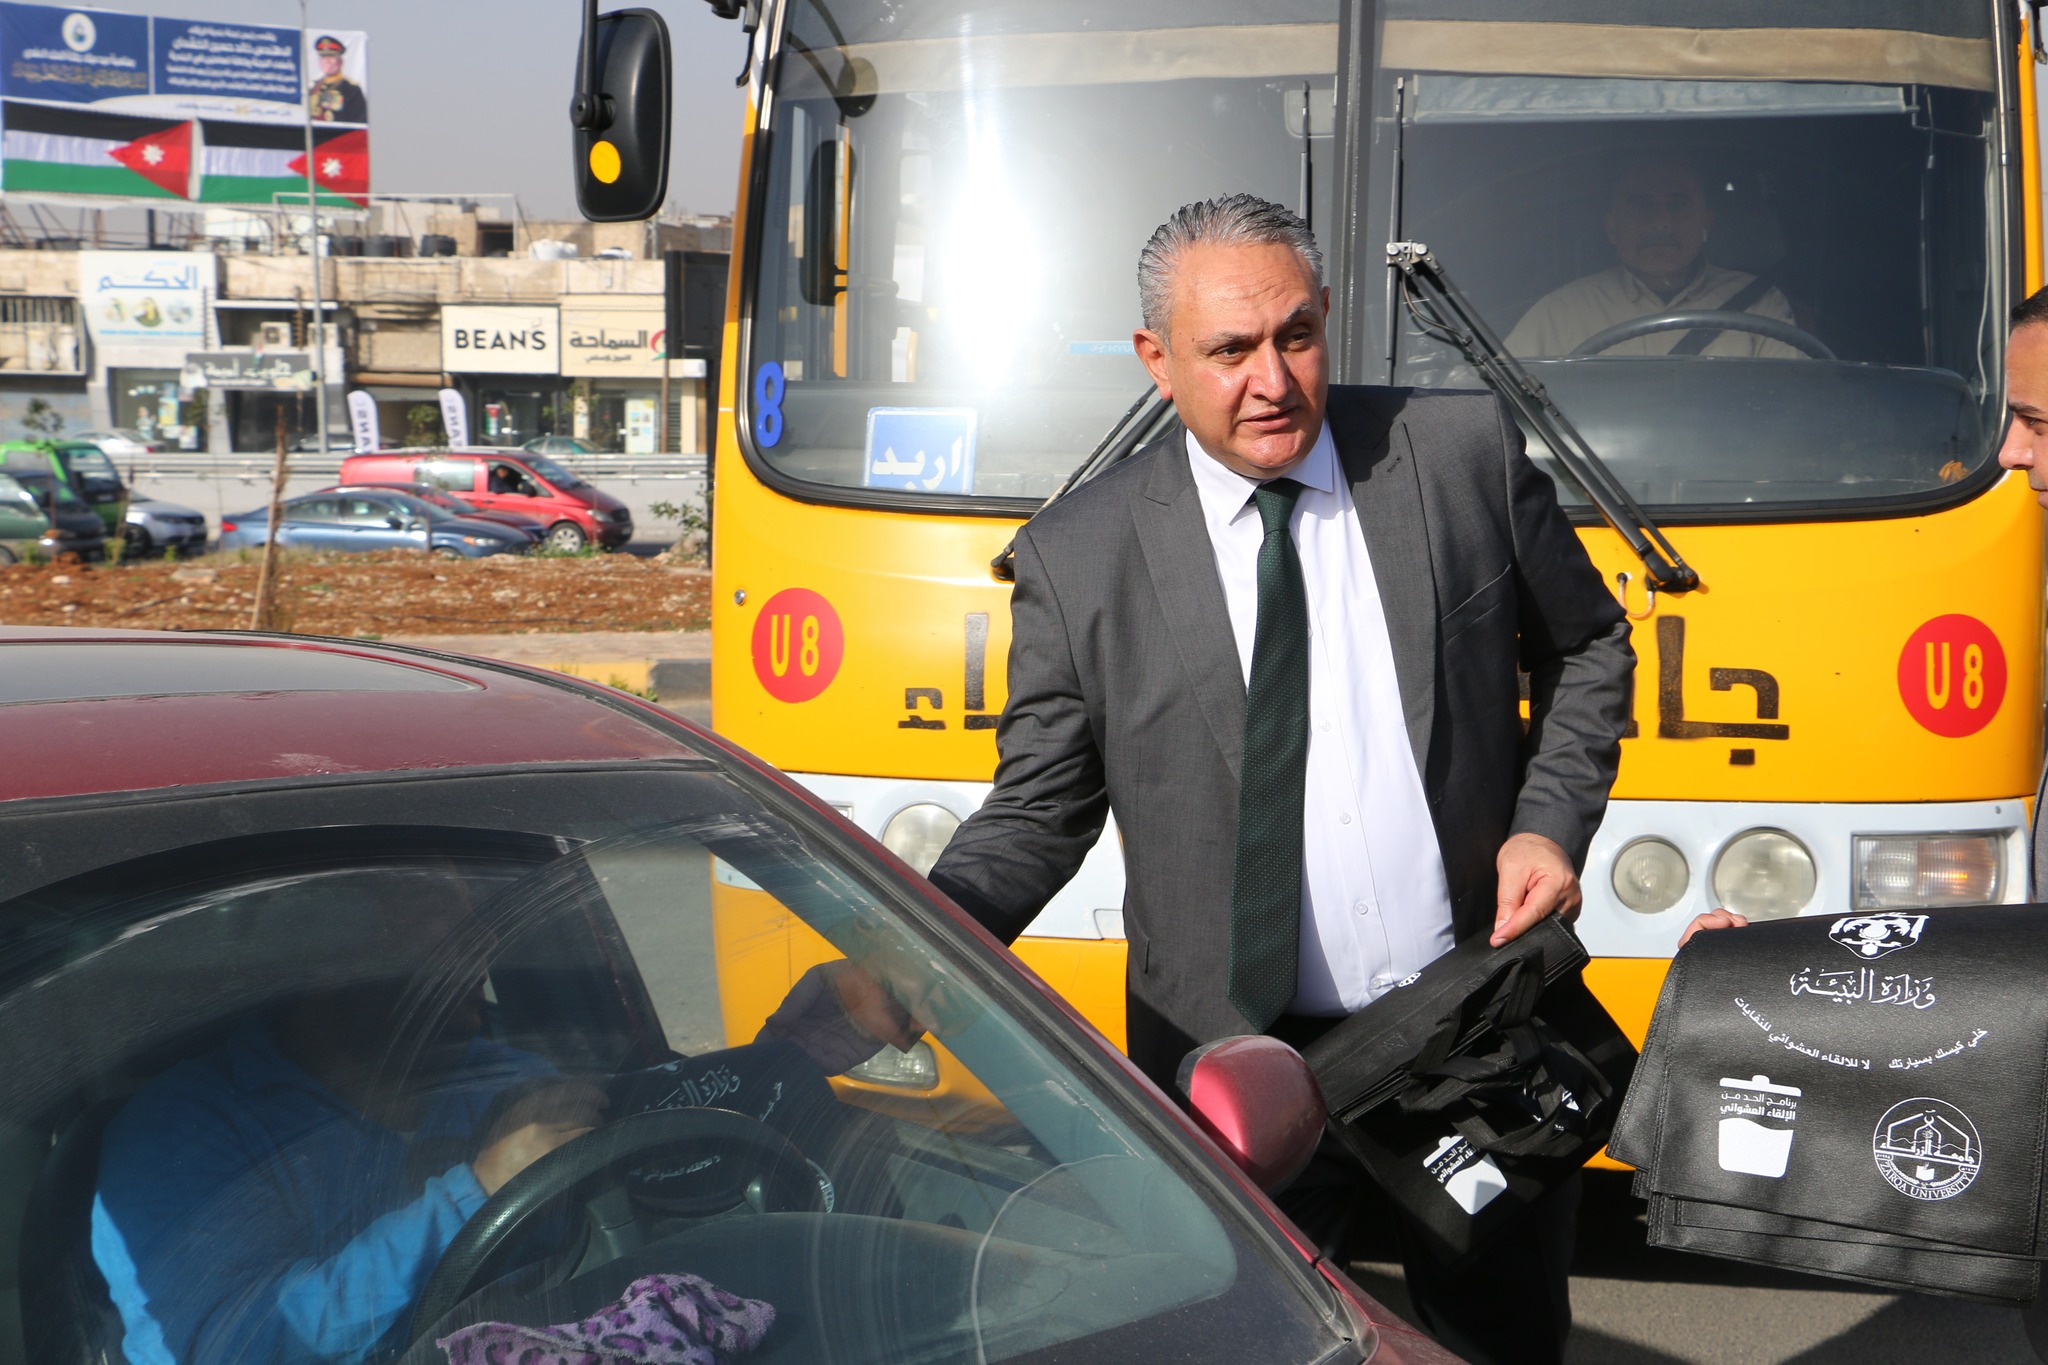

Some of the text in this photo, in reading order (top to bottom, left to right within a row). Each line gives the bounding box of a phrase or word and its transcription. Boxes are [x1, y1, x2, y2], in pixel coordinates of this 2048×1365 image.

[455, 329, 546, 350] BEANS
[755, 361, 785, 448] 8
[1734, 997, 1772, 1031] للنفايات
[1768, 1033, 1820, 1058] العشوائي
[1967, 1028, 1988, 1048] خلي
[1935, 1040, 1965, 1059] كيسك
[1861, 1059, 1871, 1070] لا
[1888, 1055, 1933, 1070] بسيارتك
[1720, 1103, 1765, 1115] العشوائي
[1721, 1091, 1797, 1109] برنامج الحد من
[1879, 1161, 1972, 1199] ZARQA UNIVERSITY
